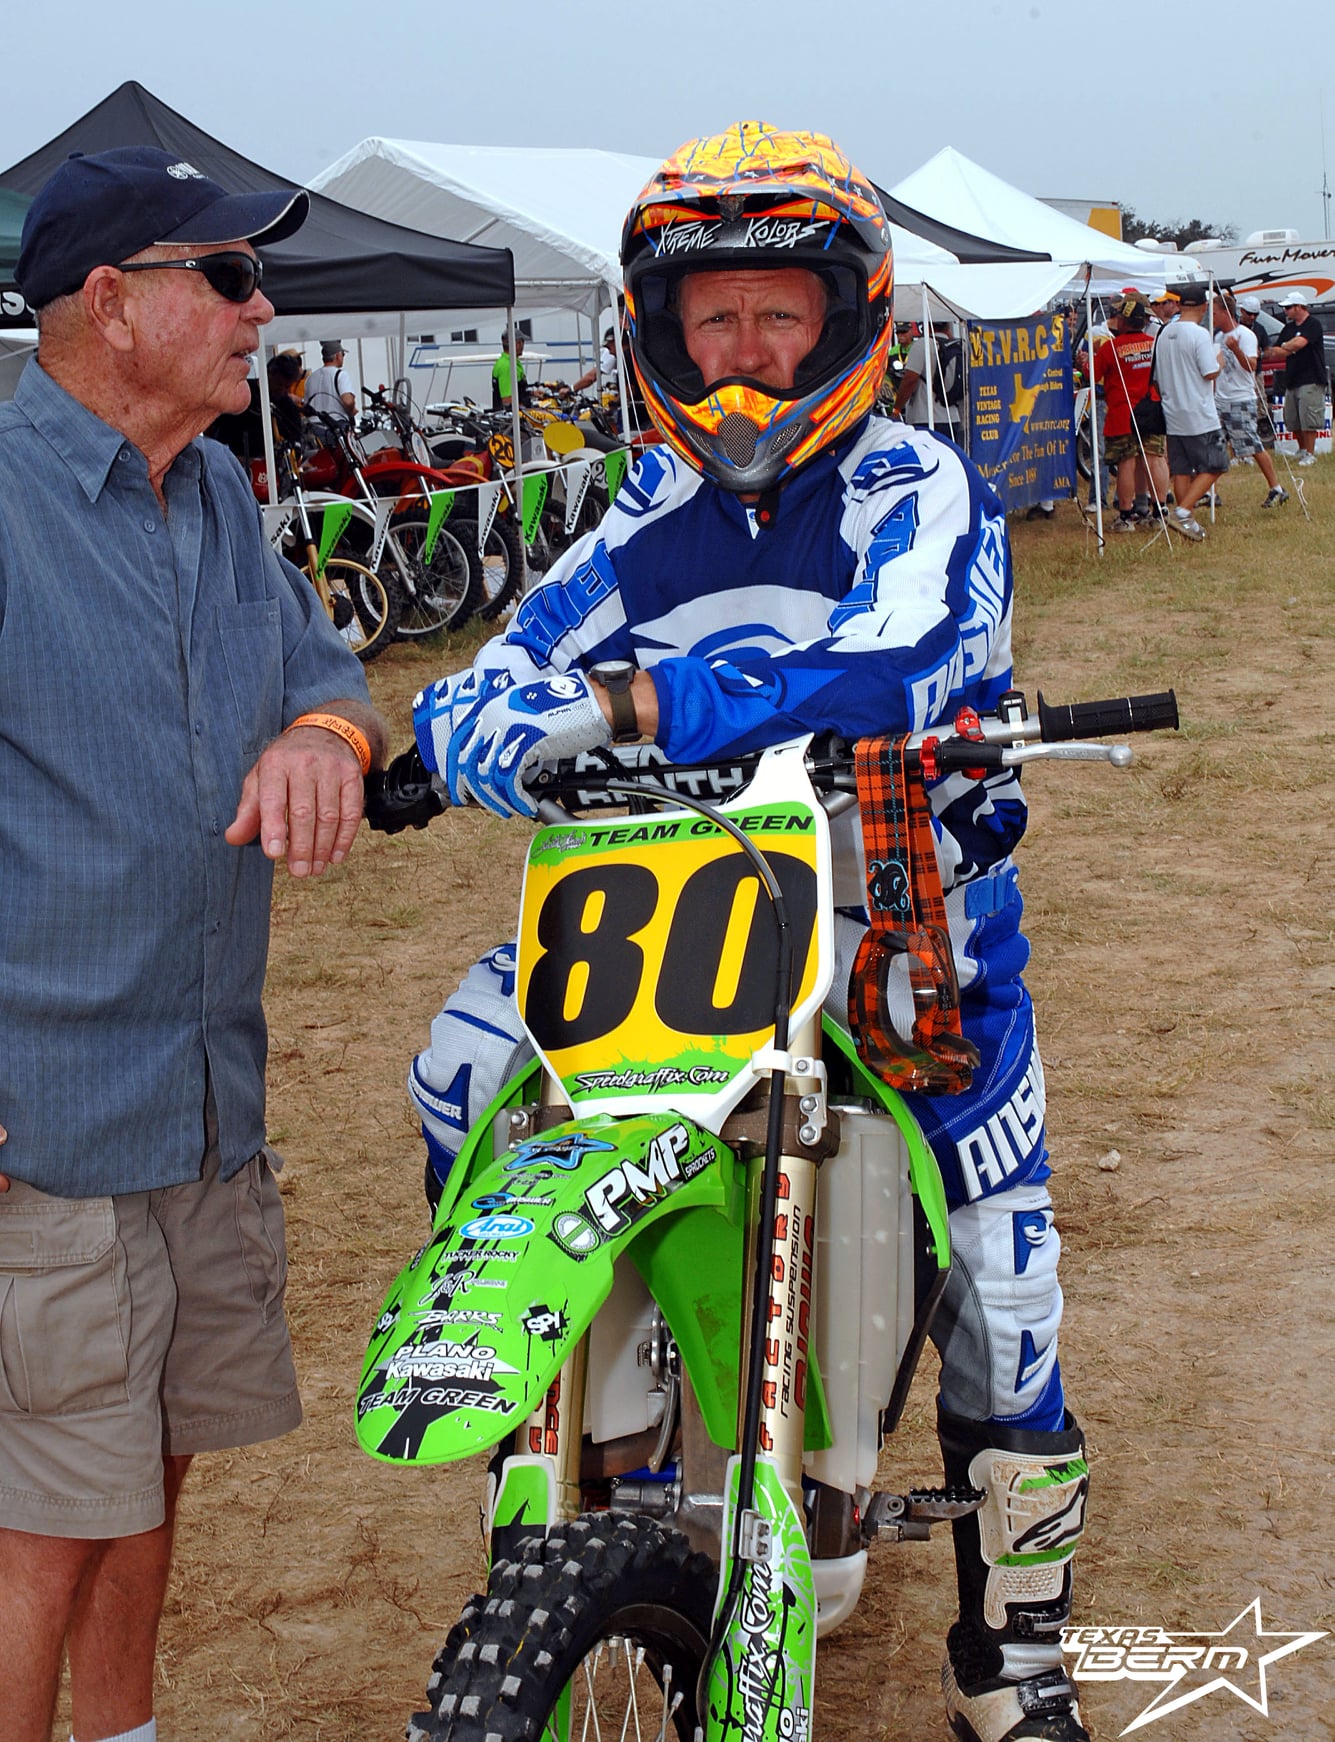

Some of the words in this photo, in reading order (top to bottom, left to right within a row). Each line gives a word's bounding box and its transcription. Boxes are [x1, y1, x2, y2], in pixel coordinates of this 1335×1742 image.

[655, 216, 722, 257] XTREME
[742, 216, 830, 248] KOLORS
[1239, 250, 1281, 266] Fun
[979, 385, 998, 397] TEXAS
[976, 399, 1002, 411] VINTAGE
[976, 413, 1000, 425] RACING
[981, 429, 999, 441] CLUB
[493, 435, 514, 467] 20
[1046, 440, 1056, 456] Of
[1053, 476, 1071, 489] AMA
[525, 479, 548, 542] Kawasaki
[566, 467, 591, 531] Kawasaki
[478, 492, 500, 554] Kawasaki
[316, 510, 351, 578] Kawasaki
[589, 824, 681, 847] TEAM
[525, 850, 818, 1051] 80
[571, 1066, 729, 1096] Speedgraffix.Com
[684, 1148, 716, 1180] SPROCKETS
[584, 1123, 690, 1232] PMP
[465, 1218, 525, 1233] Arai
[445, 1250, 483, 1259] TUCKER
[485, 1250, 519, 1260] ROCKY
[526, 1311, 561, 1336] SPY
[395, 1345, 496, 1360] PLANO
[386, 1360, 495, 1381] Kawasaki
[359, 1388, 421, 1415] TEAM
[421, 1388, 518, 1416] GREEN
